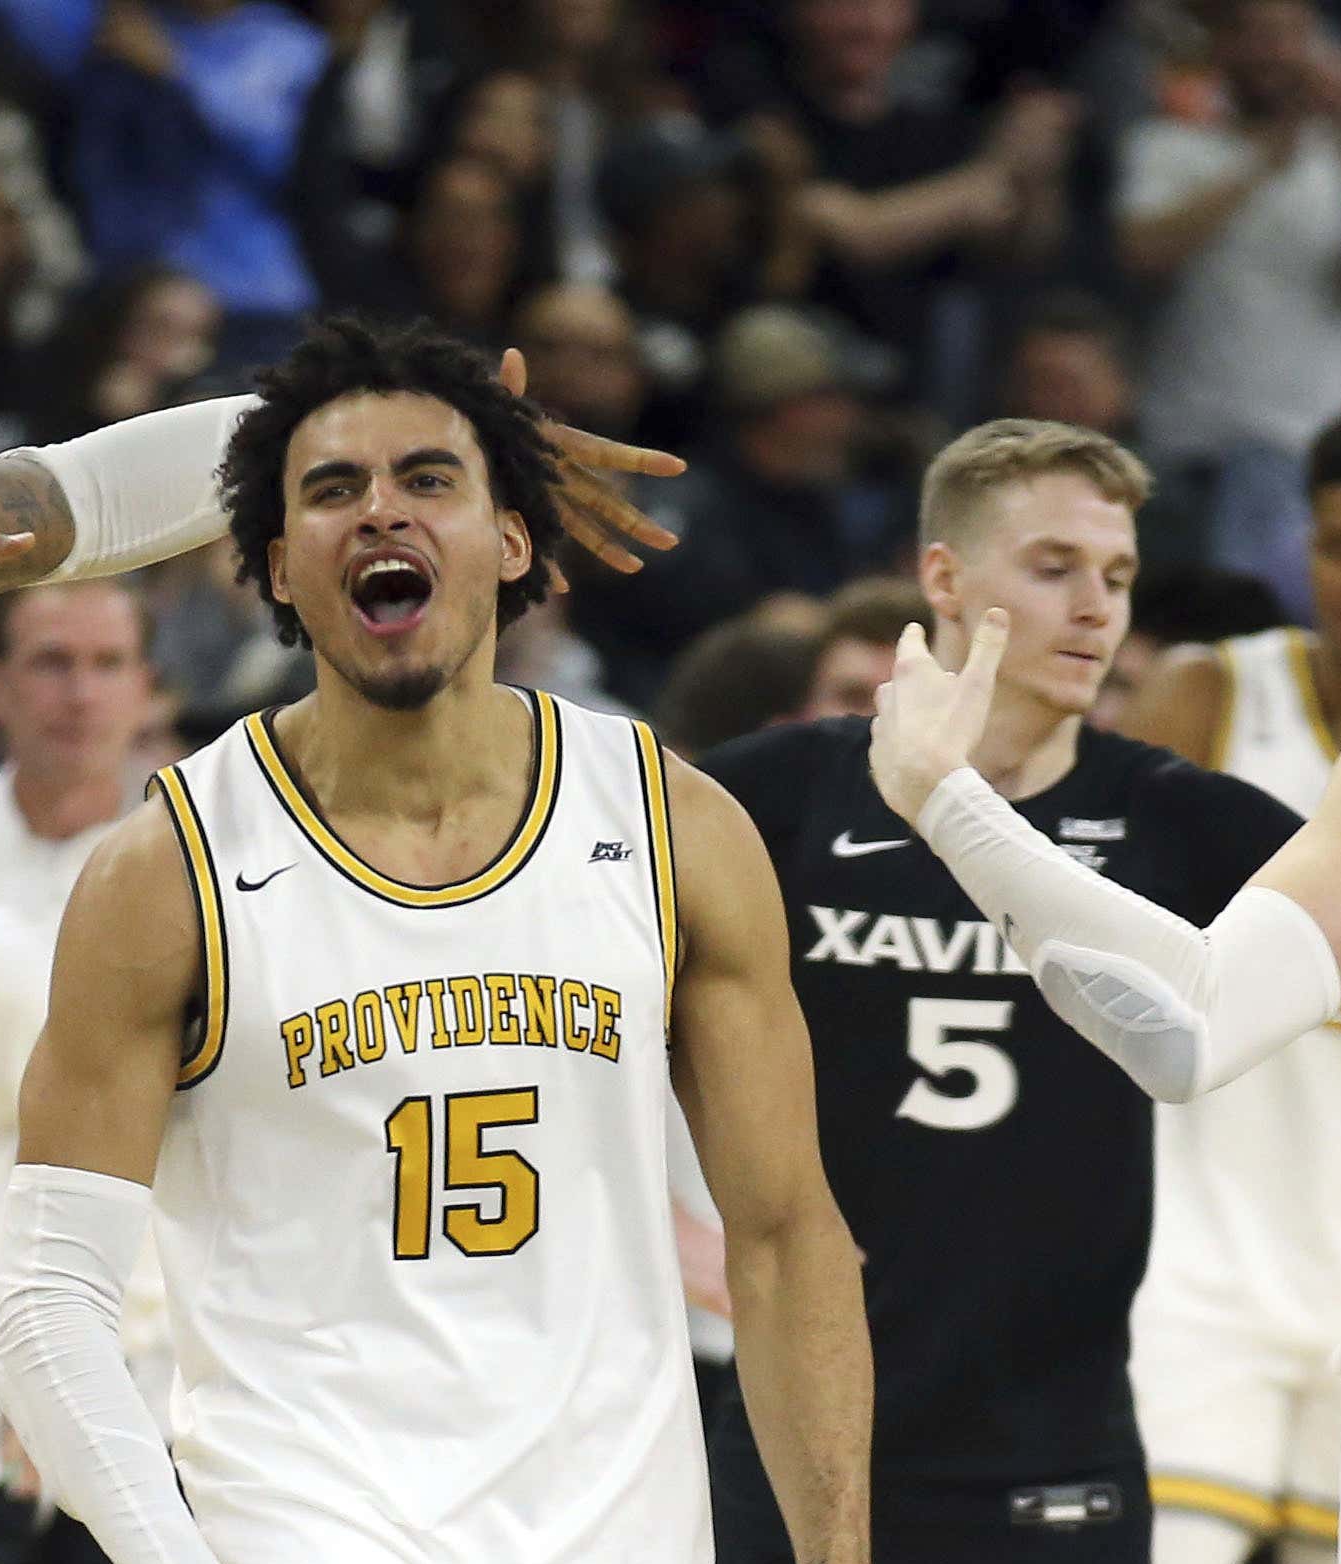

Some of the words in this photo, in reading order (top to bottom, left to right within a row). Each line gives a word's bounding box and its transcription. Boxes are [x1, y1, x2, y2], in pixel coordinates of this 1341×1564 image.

[280, 973, 623, 1088] PROVIDENCE
[895, 996, 1019, 1130] 5
[385, 1085, 540, 1260] 15
